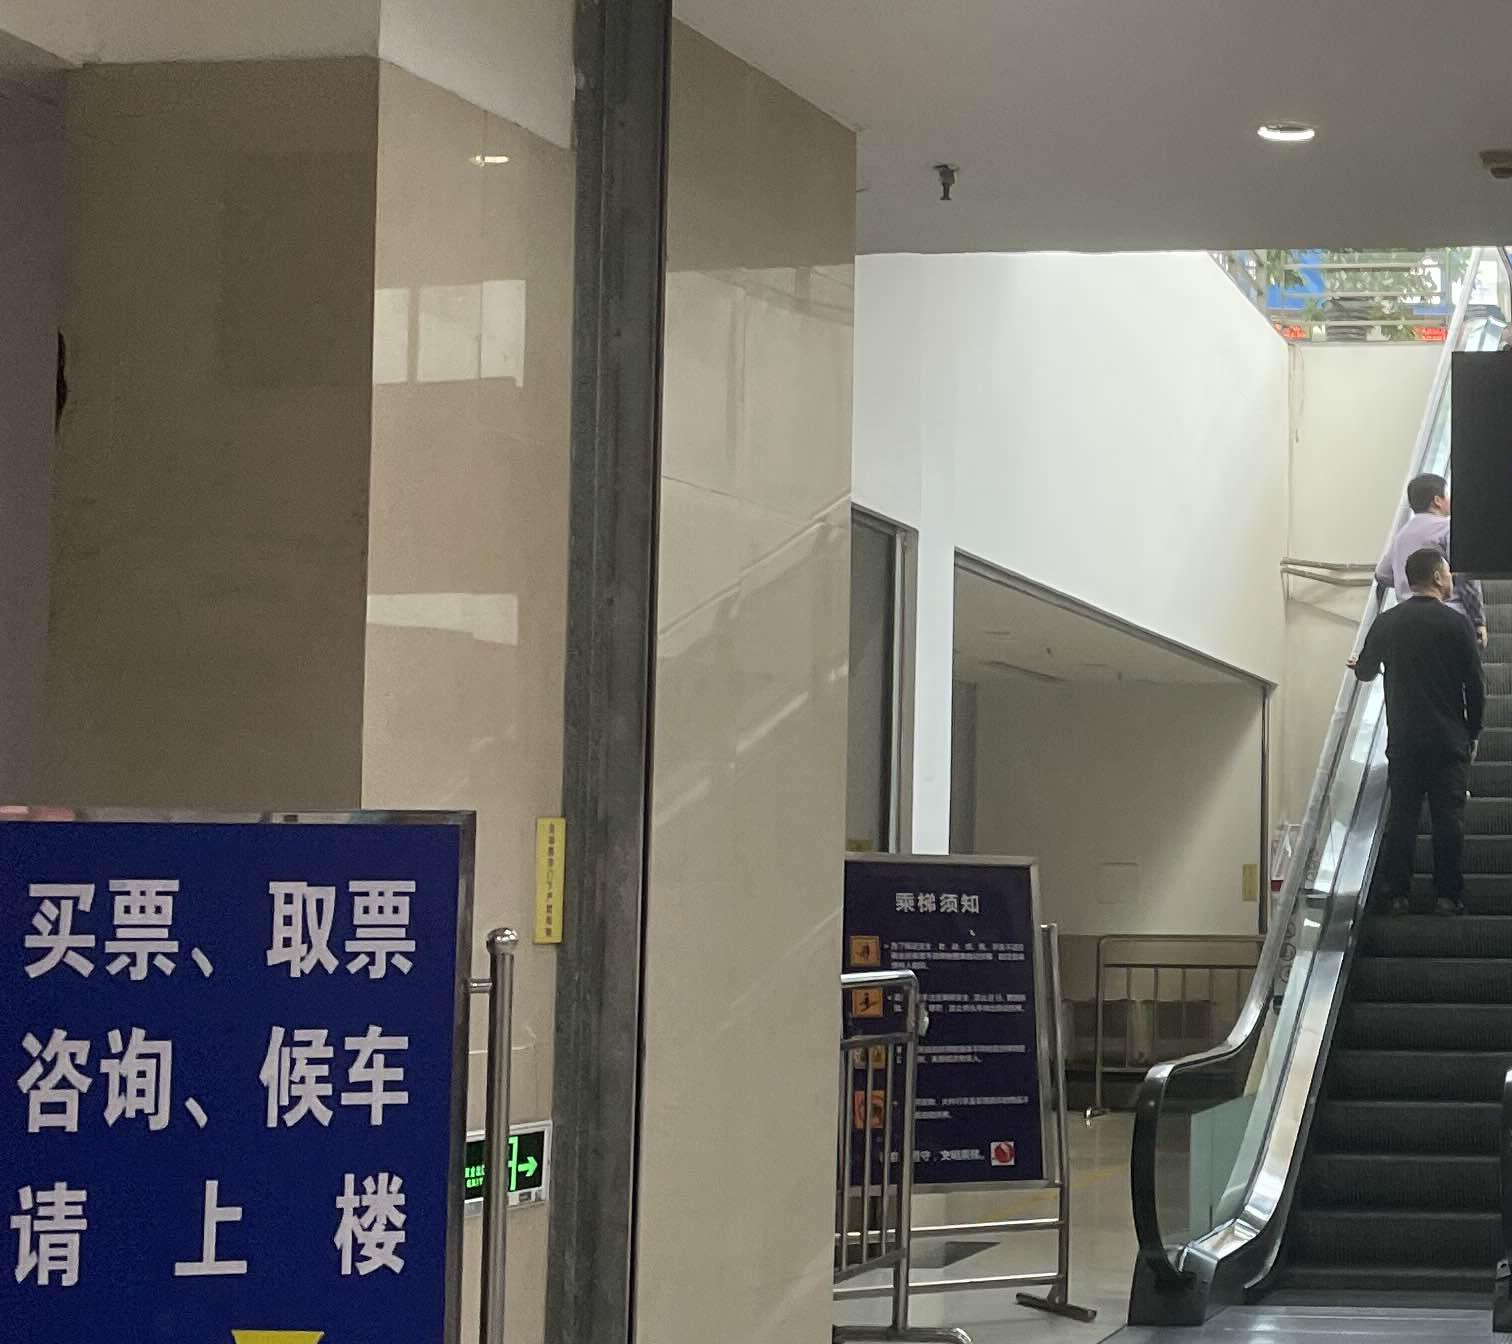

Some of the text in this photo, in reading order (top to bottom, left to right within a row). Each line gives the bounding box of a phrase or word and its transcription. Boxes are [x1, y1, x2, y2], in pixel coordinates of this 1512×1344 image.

[23, 879, 417, 981] 买票、取票
[895, 892, 981, 915] 乘梯须知
[17, 1025, 410, 1133] 咨询、候车
